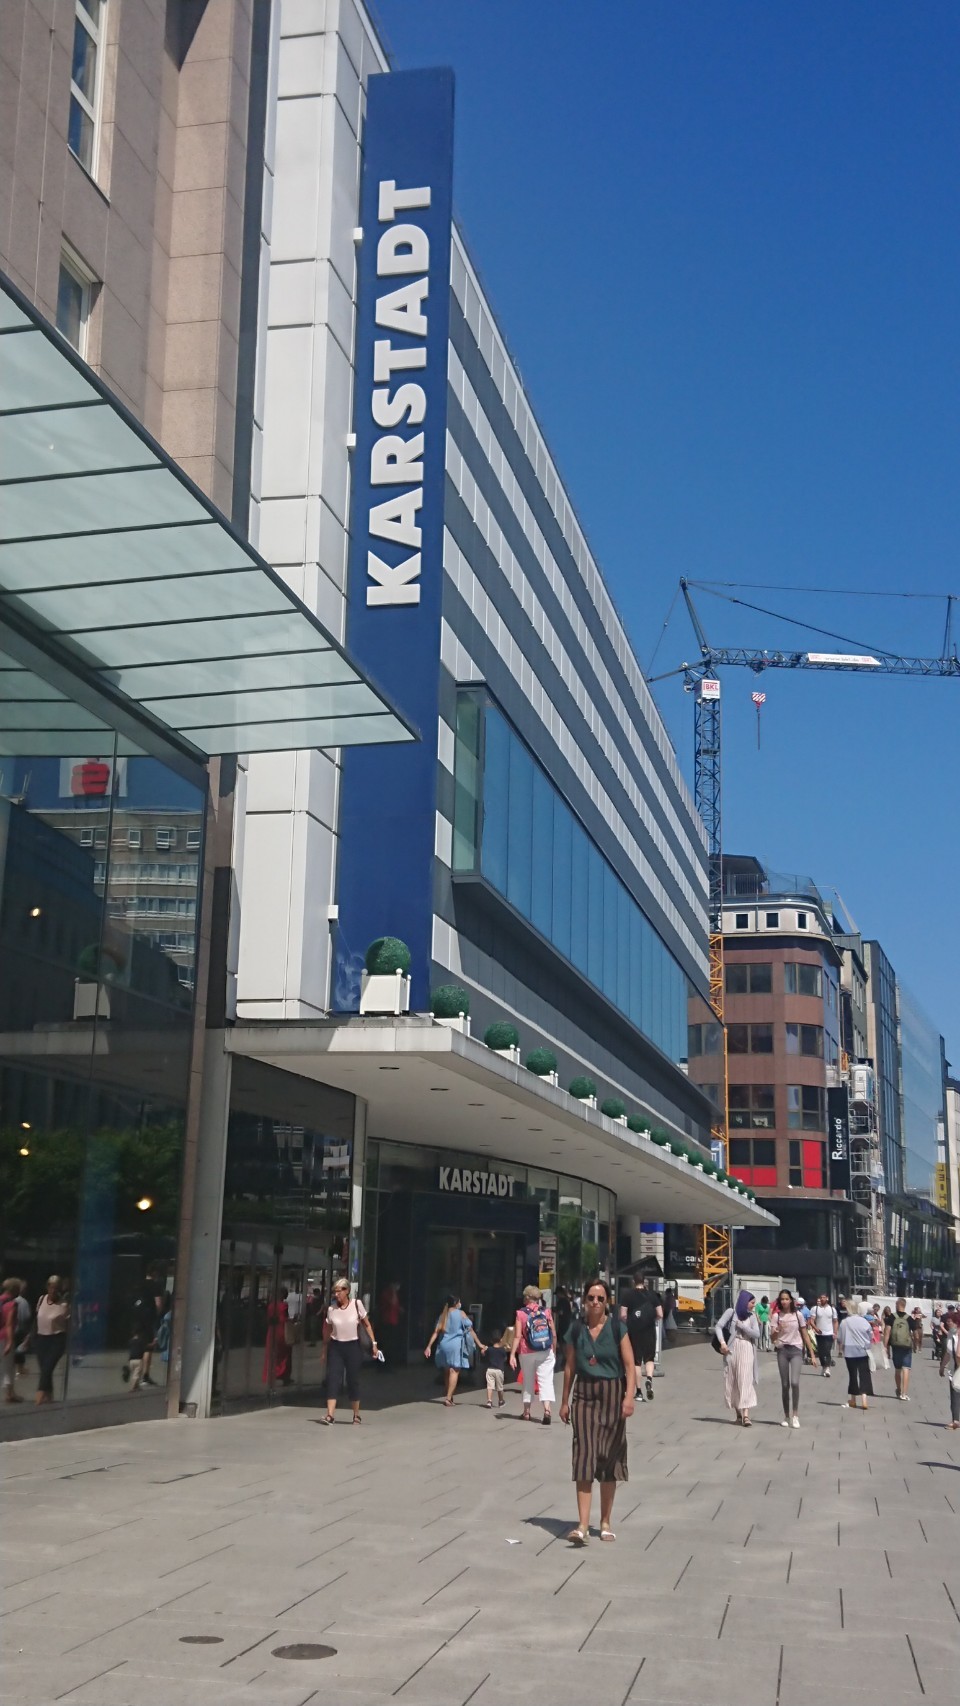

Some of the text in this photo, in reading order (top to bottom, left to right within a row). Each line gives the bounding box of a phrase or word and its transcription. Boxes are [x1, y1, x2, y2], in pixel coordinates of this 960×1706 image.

[367, 180, 431, 607] KARSTADT
[831, 1118, 843, 1160] Riccardo
[439, 1166, 515, 1197] KARSTADT
